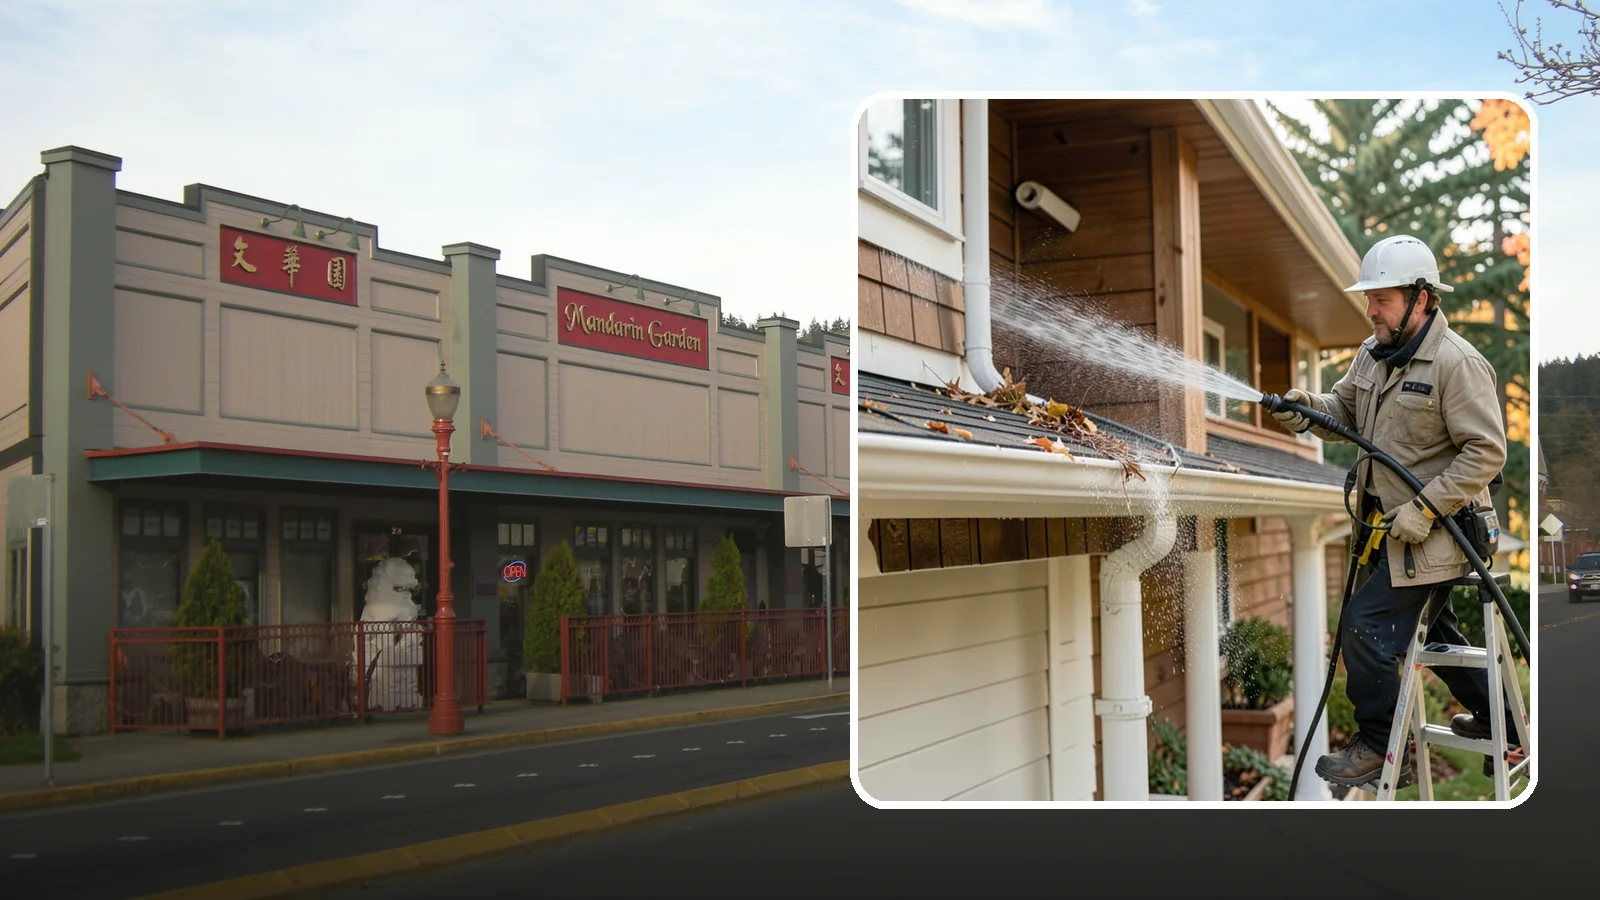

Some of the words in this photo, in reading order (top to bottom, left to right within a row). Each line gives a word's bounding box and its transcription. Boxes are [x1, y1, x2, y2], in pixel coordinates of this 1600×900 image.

[565, 302, 643, 341] Mandarin
[649, 321, 701, 352] Garden
[503, 565, 526, 578] OPEN
